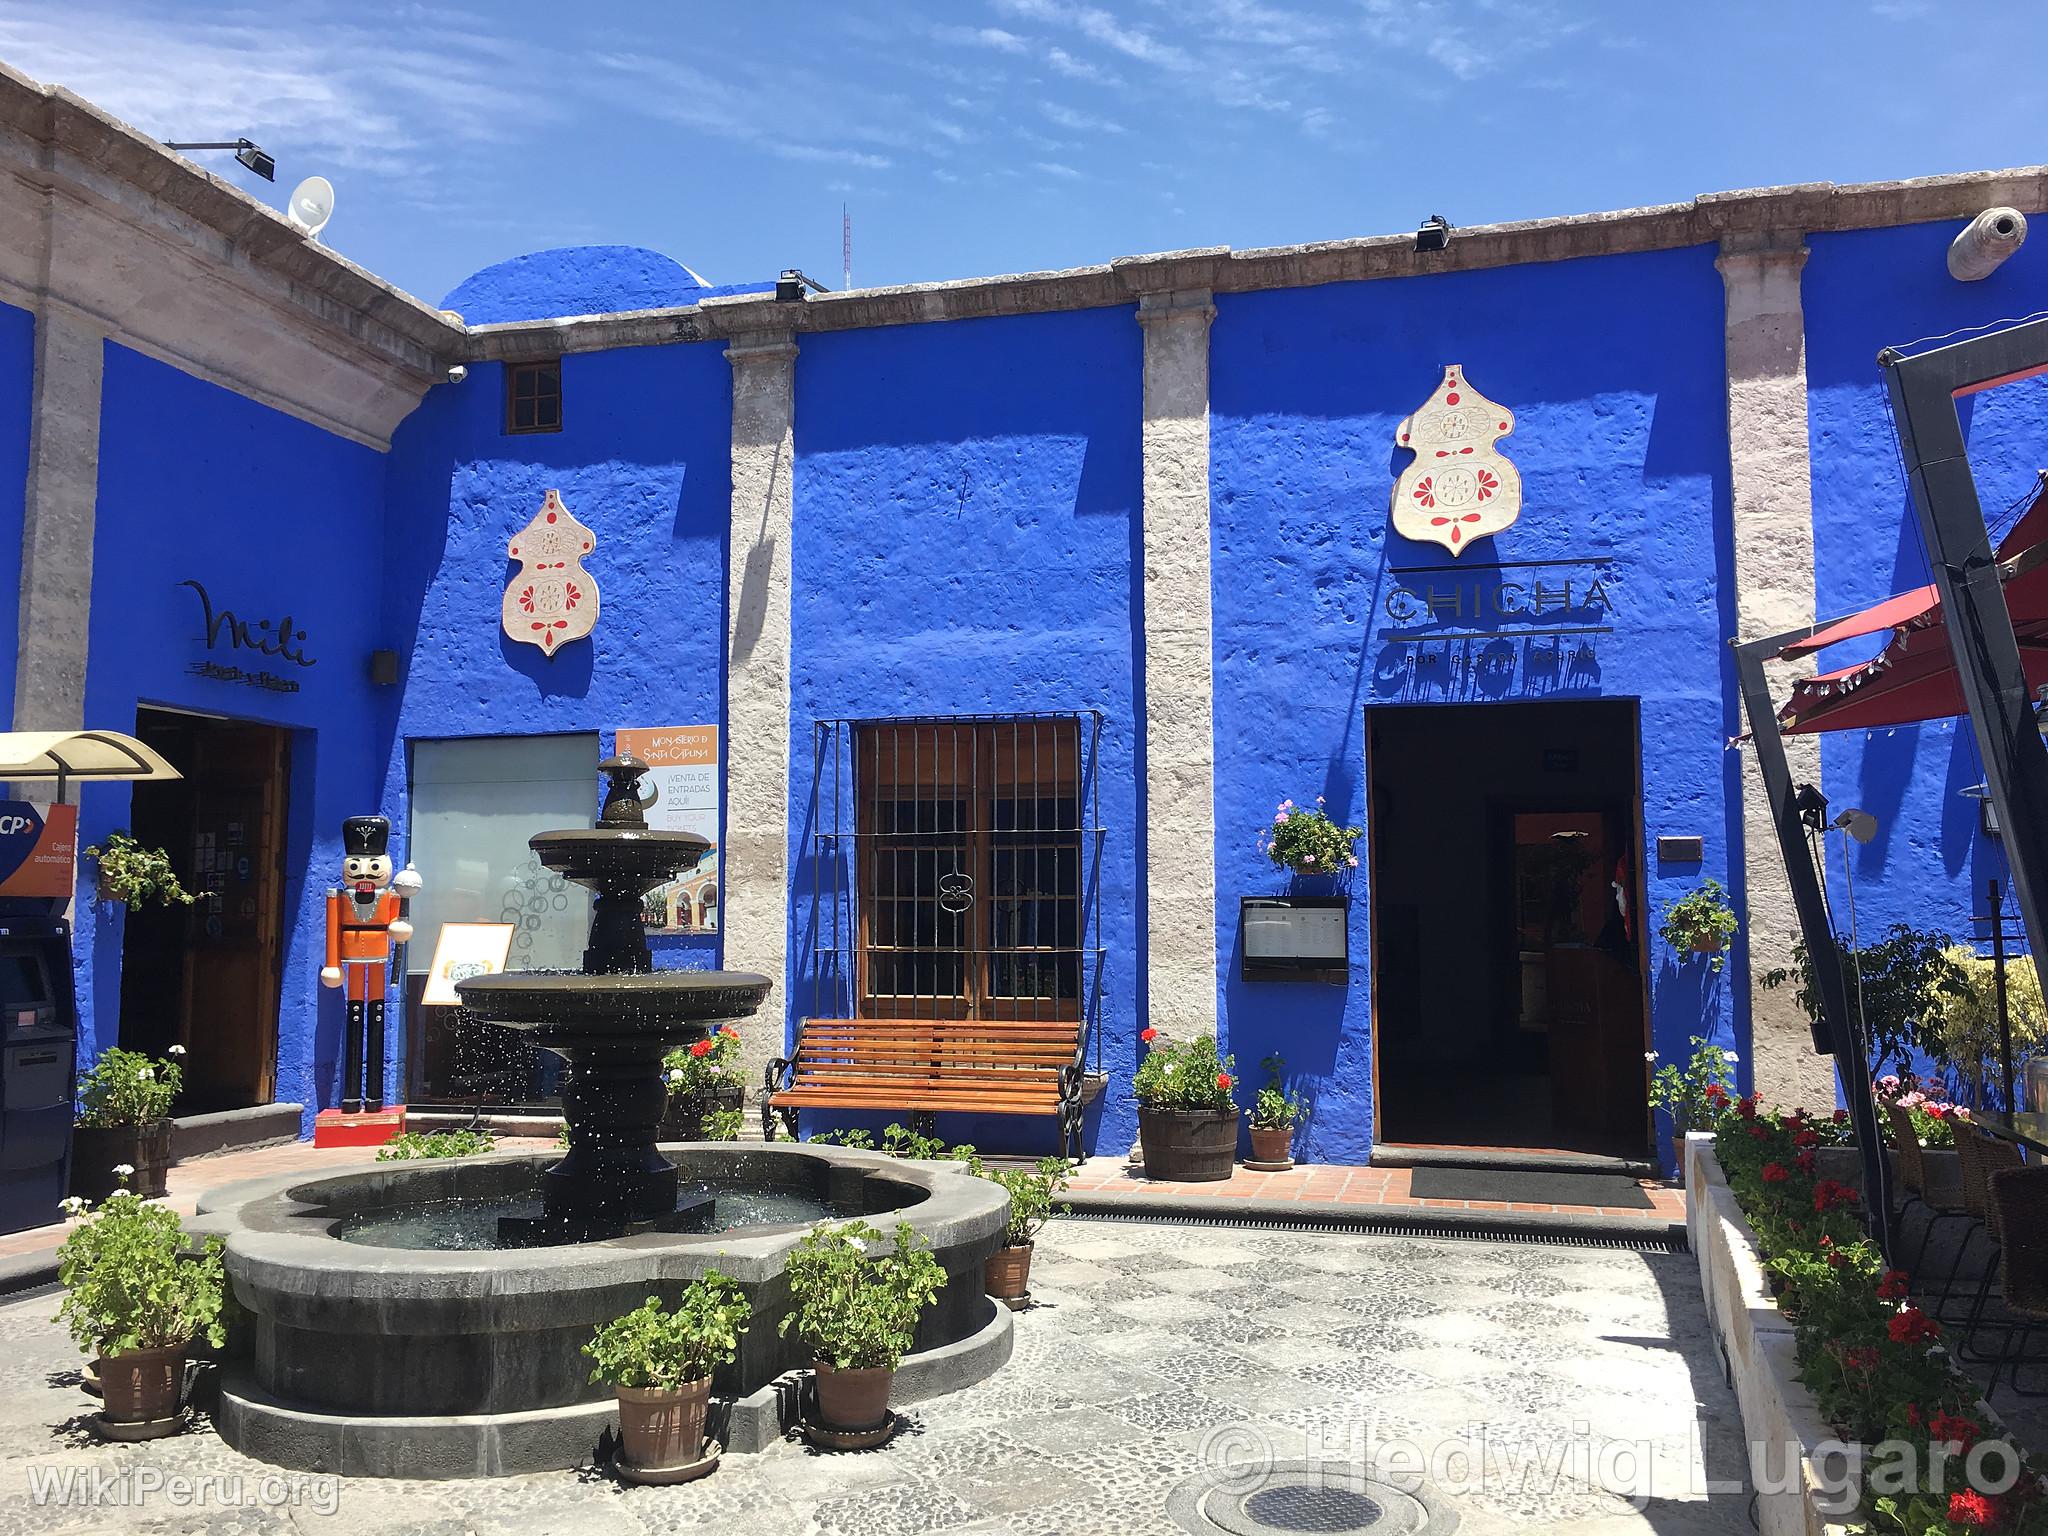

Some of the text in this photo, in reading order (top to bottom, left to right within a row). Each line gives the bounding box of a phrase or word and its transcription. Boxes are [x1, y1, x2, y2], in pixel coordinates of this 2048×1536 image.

[1385, 579, 1613, 621] CHICHA
[1407, 655, 1437, 665] POR
[698, 773, 709, 781] DE
[668, 784, 711, 794] ENTRADAS
[53, 842, 71, 852] Cajero
[35, 853, 71, 864] automático
